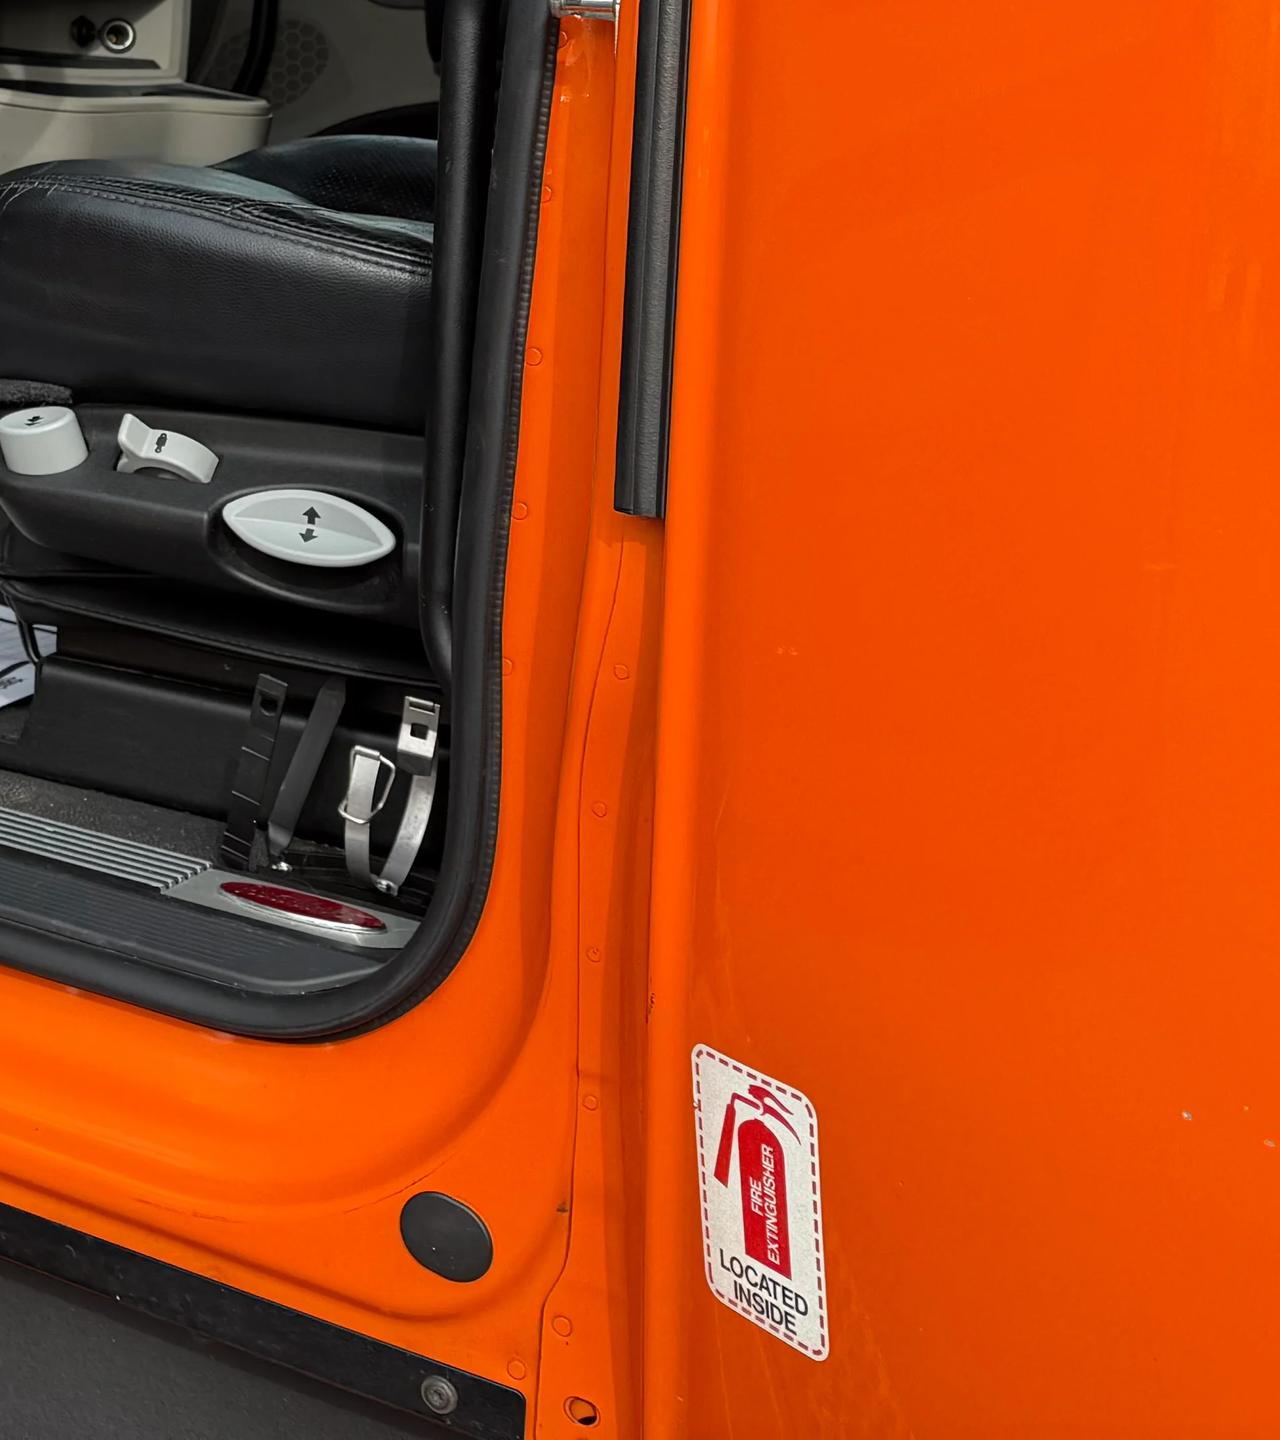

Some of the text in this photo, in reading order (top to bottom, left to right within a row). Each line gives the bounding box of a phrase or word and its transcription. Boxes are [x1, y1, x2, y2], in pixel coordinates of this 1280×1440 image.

[751, 1176, 763, 1216] FIRE
[762, 1146, 780, 1266] EXTINGUISHER
[719, 1248, 808, 1317] LOCATED
[734, 1280, 797, 1336] INSIDE
